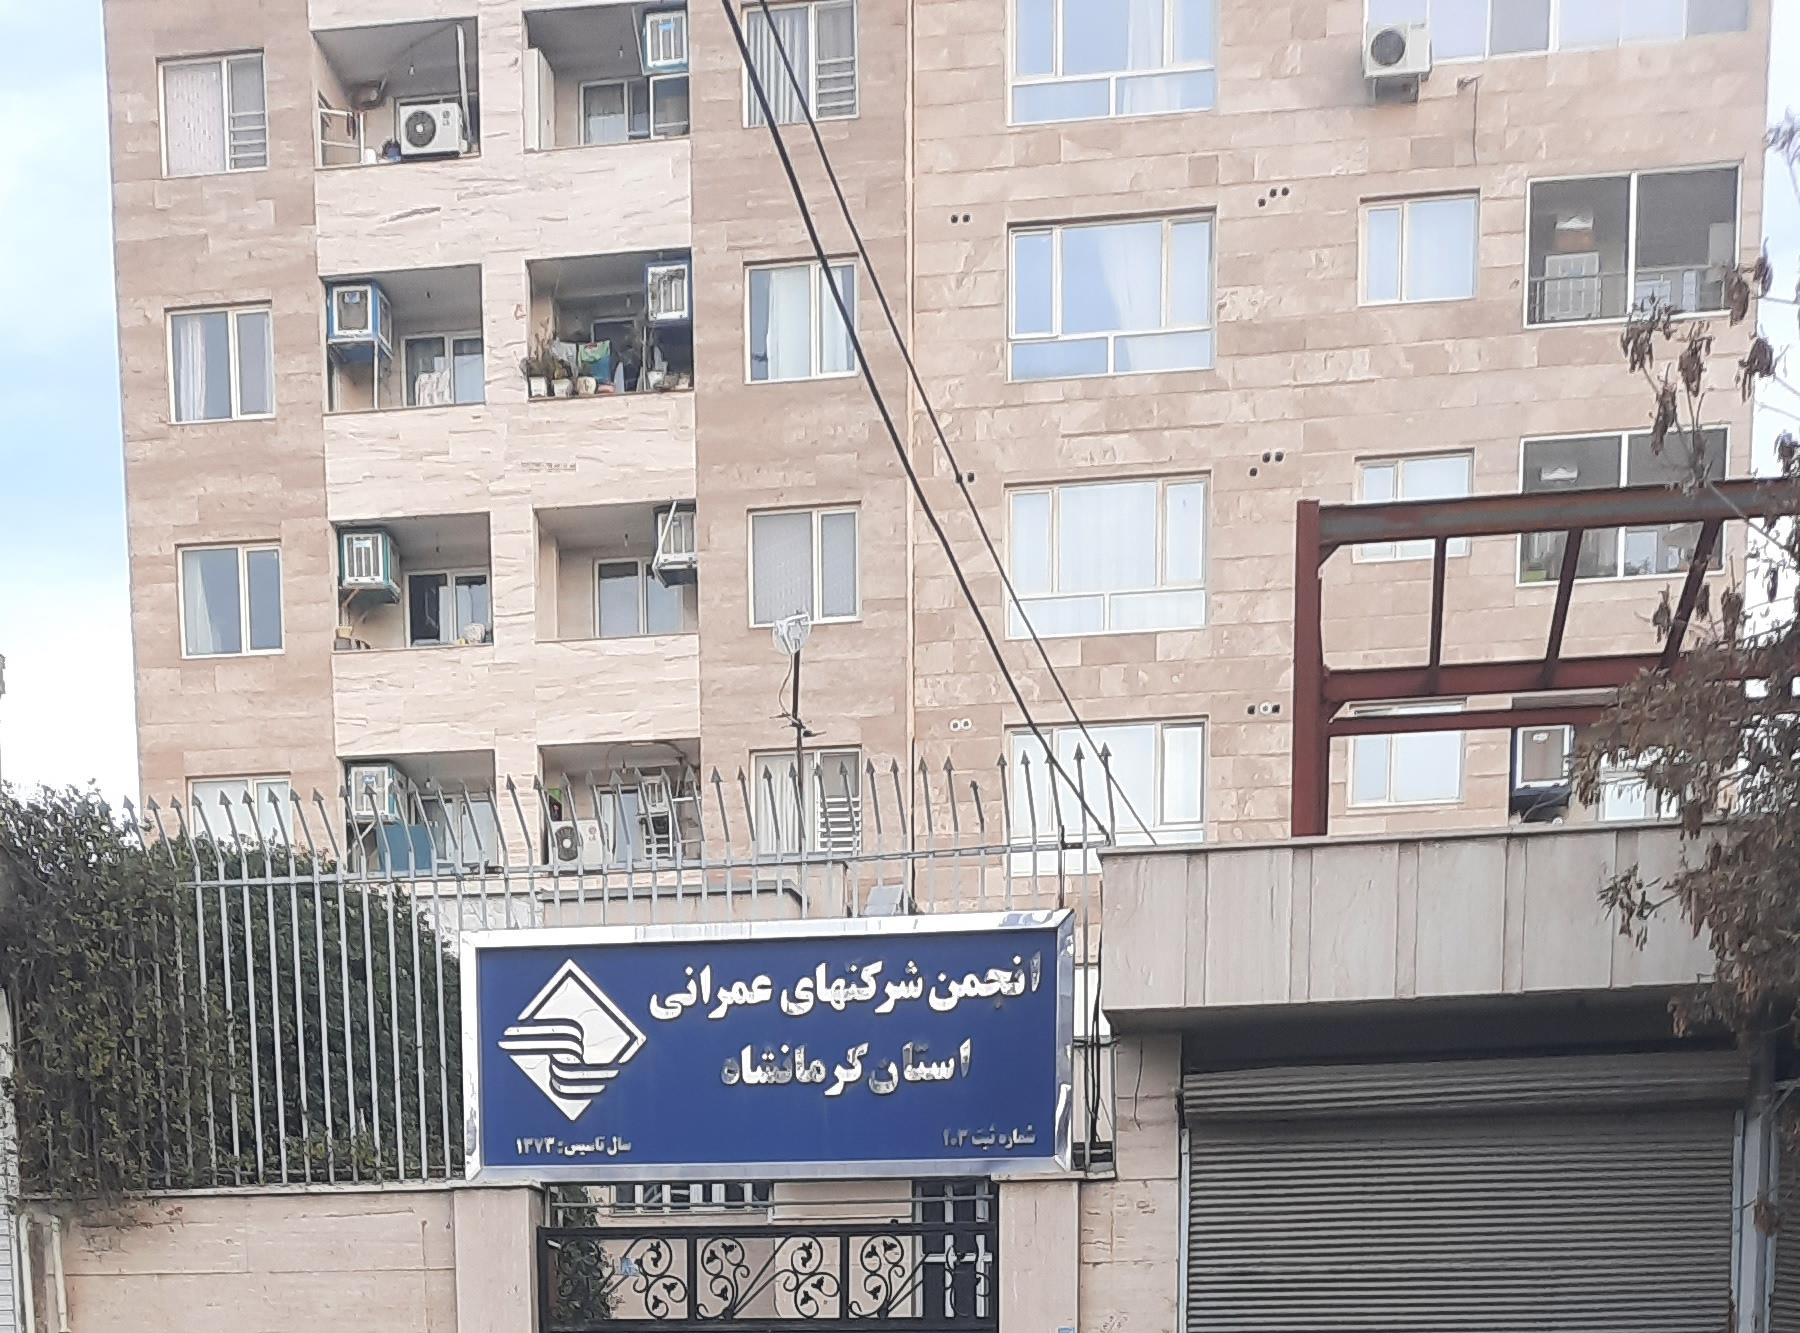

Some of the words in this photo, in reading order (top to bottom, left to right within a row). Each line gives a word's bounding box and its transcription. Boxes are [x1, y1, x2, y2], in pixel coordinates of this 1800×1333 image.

[650, 964, 773, 1019] عمرانی
[928, 951, 1041, 1011] انجمن
[720, 1041, 869, 1096] کرمانشاه
[868, 1037, 971, 1094] استان
[606, 1135, 632, 1156] سال
[971, 1123, 996, 1151] ثبت
[998, 1124, 1036, 1149] شماره
